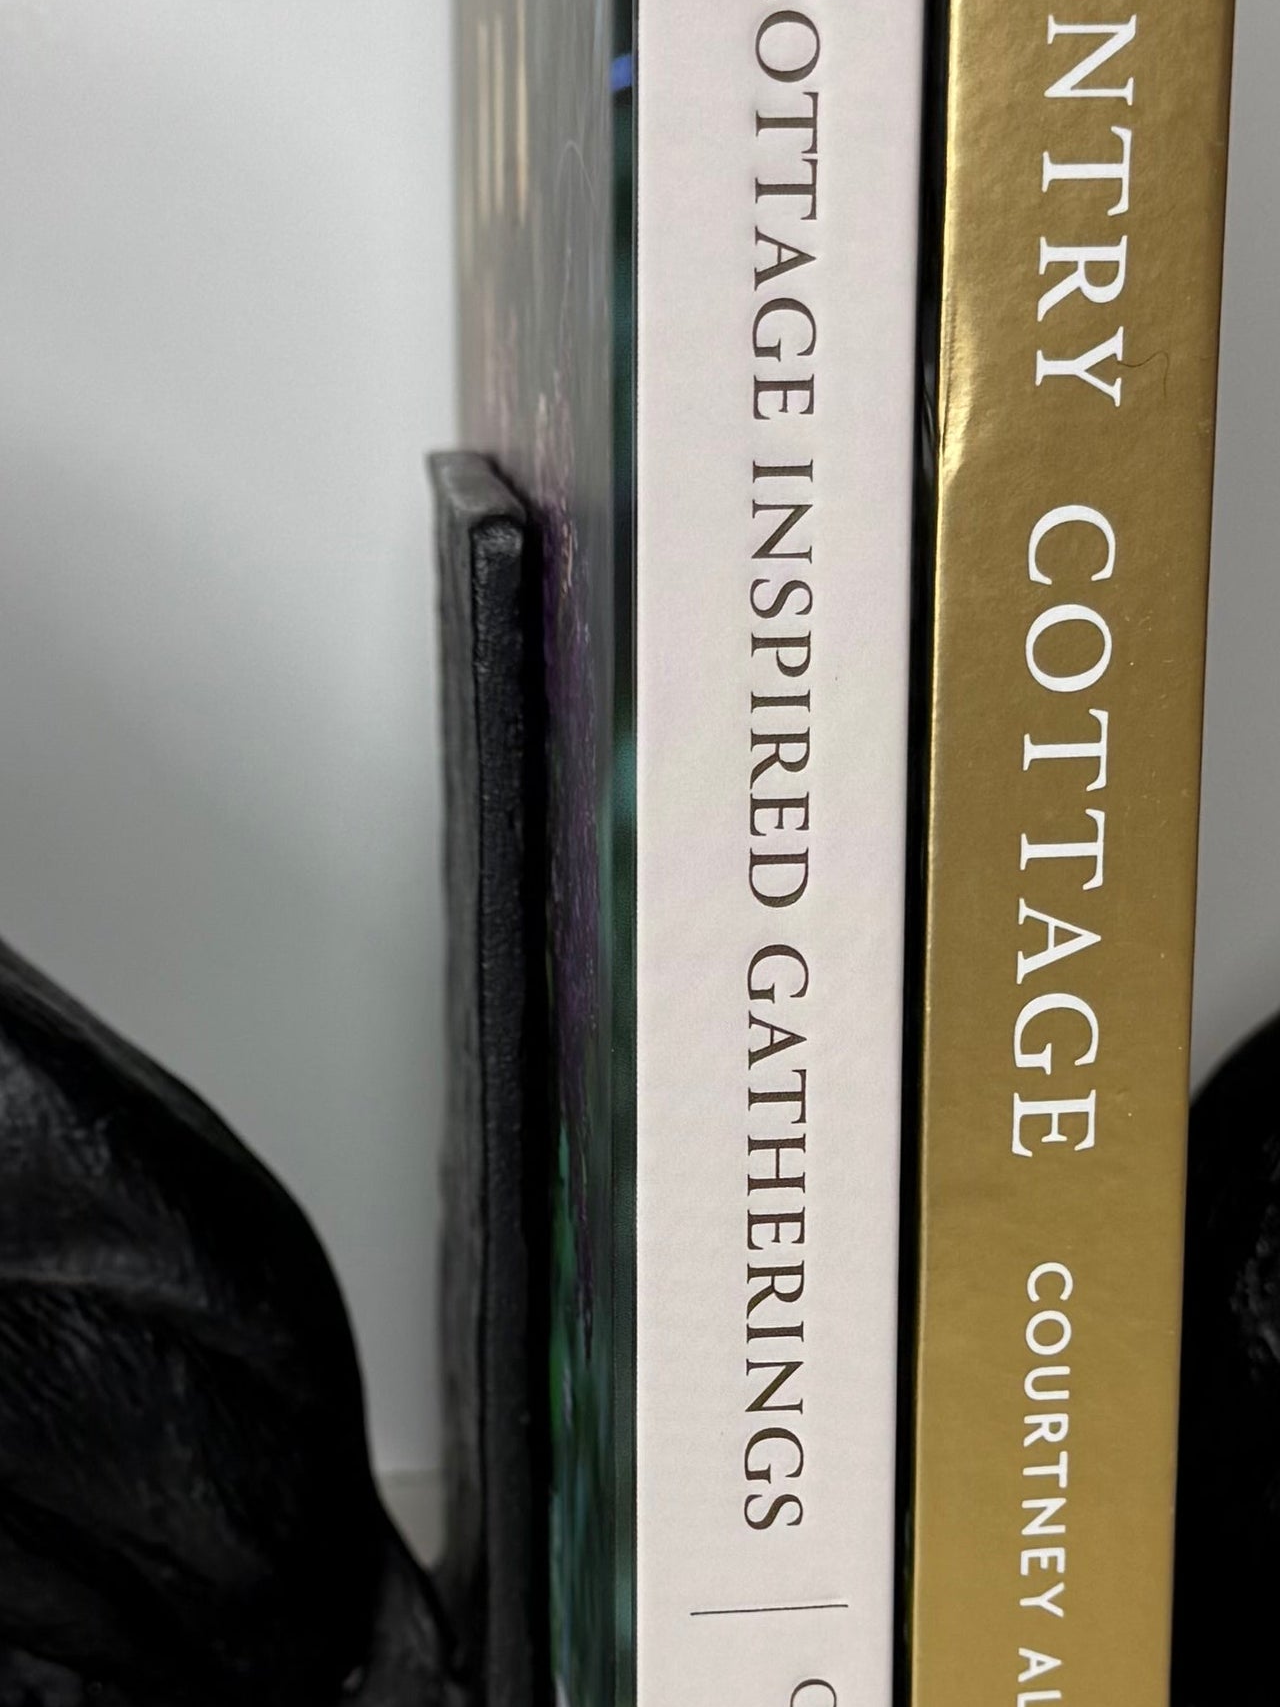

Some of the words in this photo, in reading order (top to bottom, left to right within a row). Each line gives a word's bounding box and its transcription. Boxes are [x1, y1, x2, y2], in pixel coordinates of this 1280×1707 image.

[748, 459, 814, 909] INSPIRED
[1011, 504, 1116, 1157] COTTAGE
[743, 943, 809, 1531] GATHERINGS
[1019, 1262, 1074, 1618] COURTNEY
